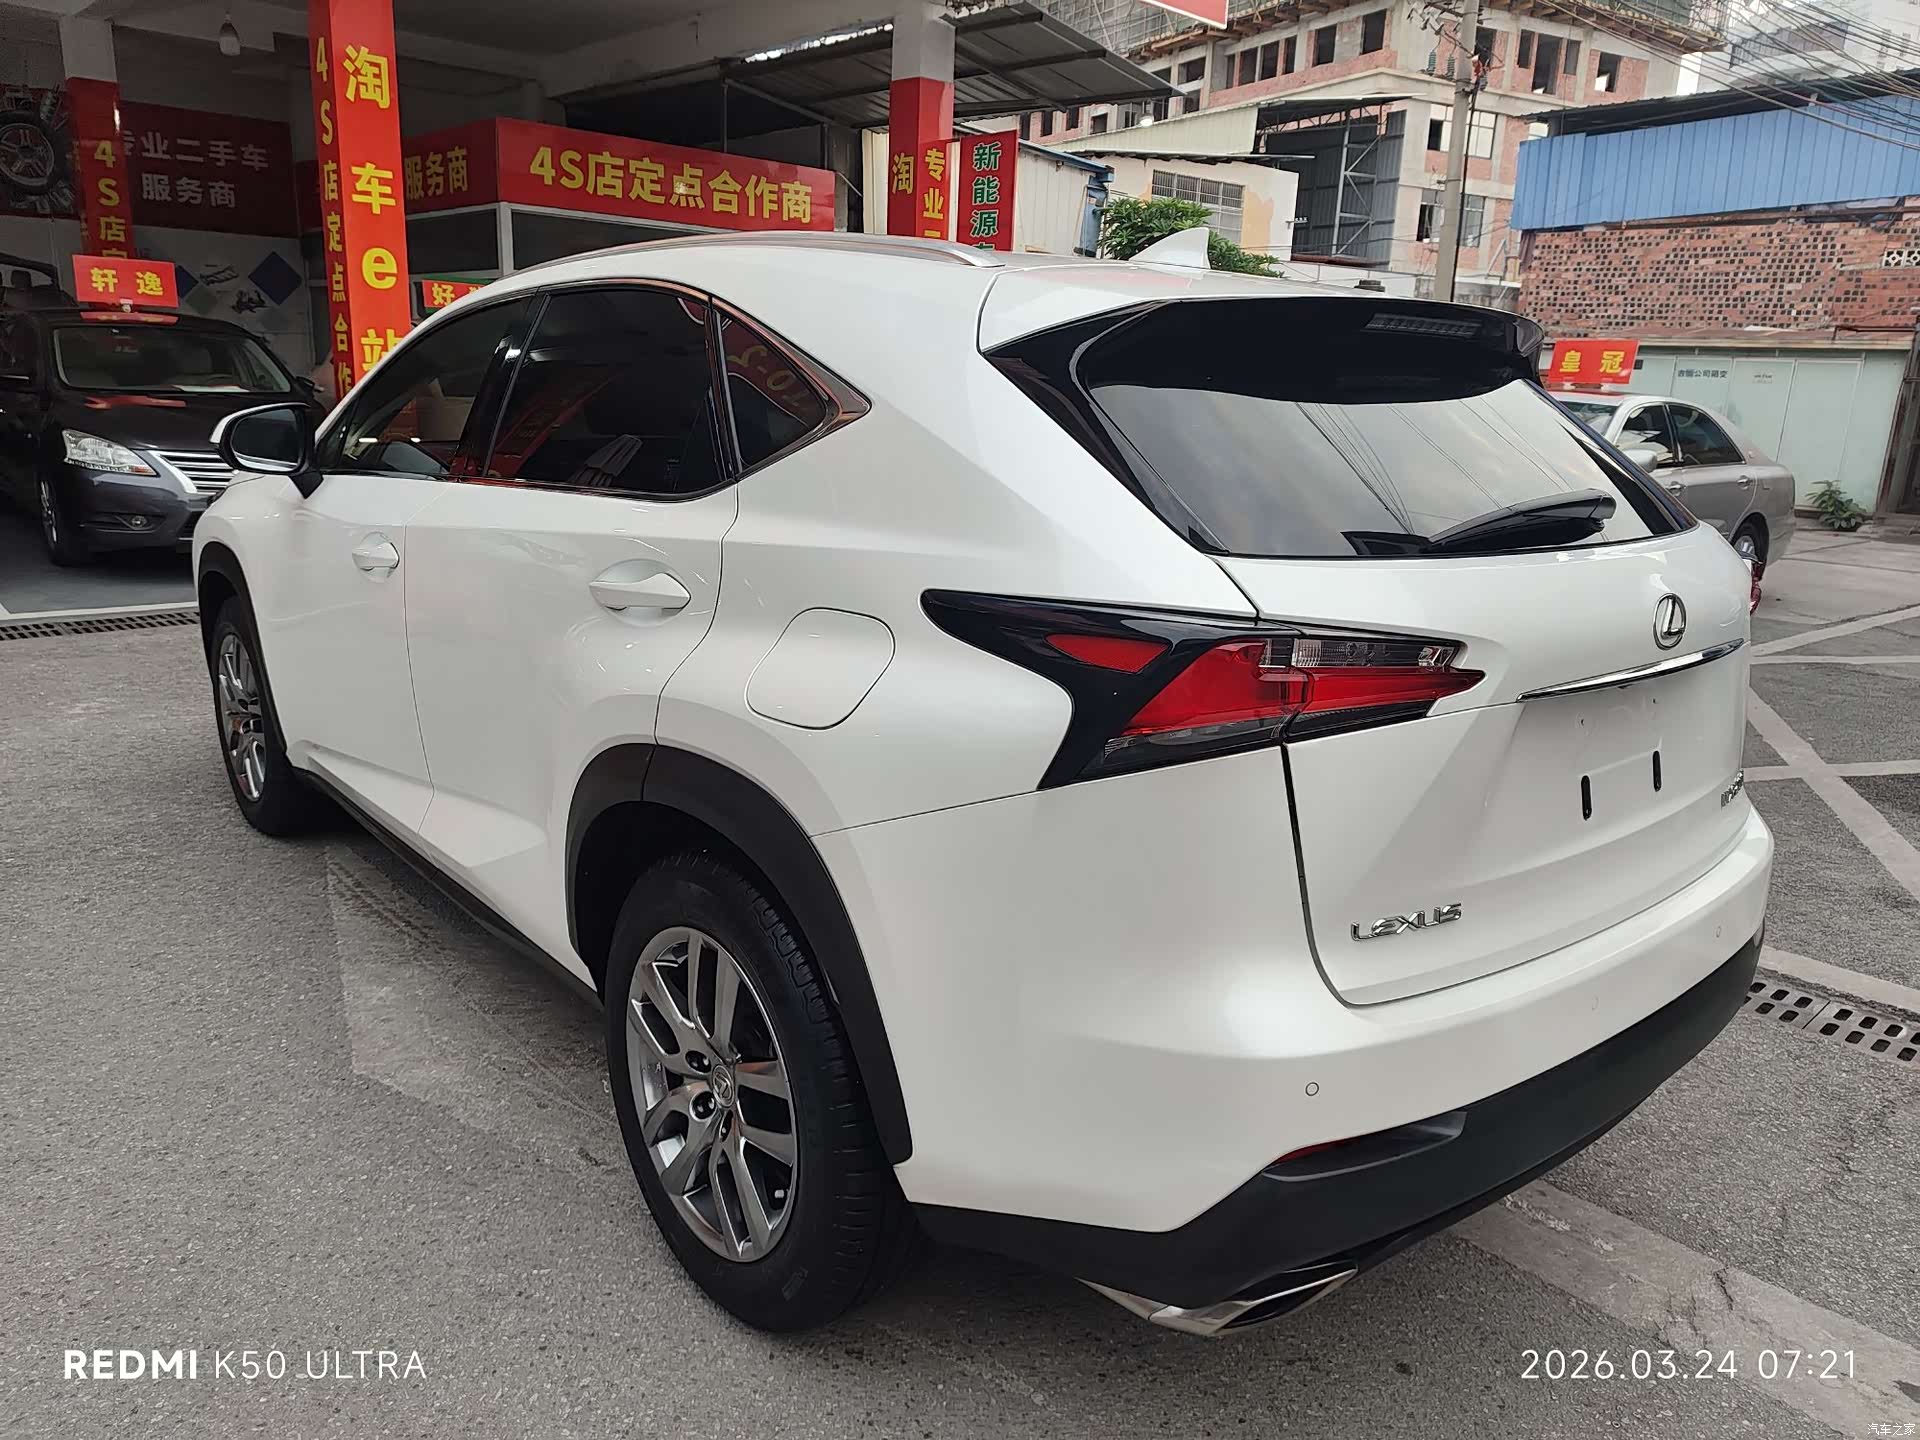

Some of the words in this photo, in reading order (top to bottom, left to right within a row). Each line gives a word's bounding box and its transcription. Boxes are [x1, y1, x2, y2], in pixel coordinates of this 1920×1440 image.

[142, 172, 236, 208] 服务商
[405, 146, 468, 201] 服务商
[529, 146, 812, 224] 4S店定点合作商
[892, 152, 915, 195] 淘
[342, 45, 404, 372] 淘车e站
[90, 267, 164, 296] 轩逸
[1559, 349, 1625, 374] 皇冠
[1350, 902, 1463, 942] LEXUS
